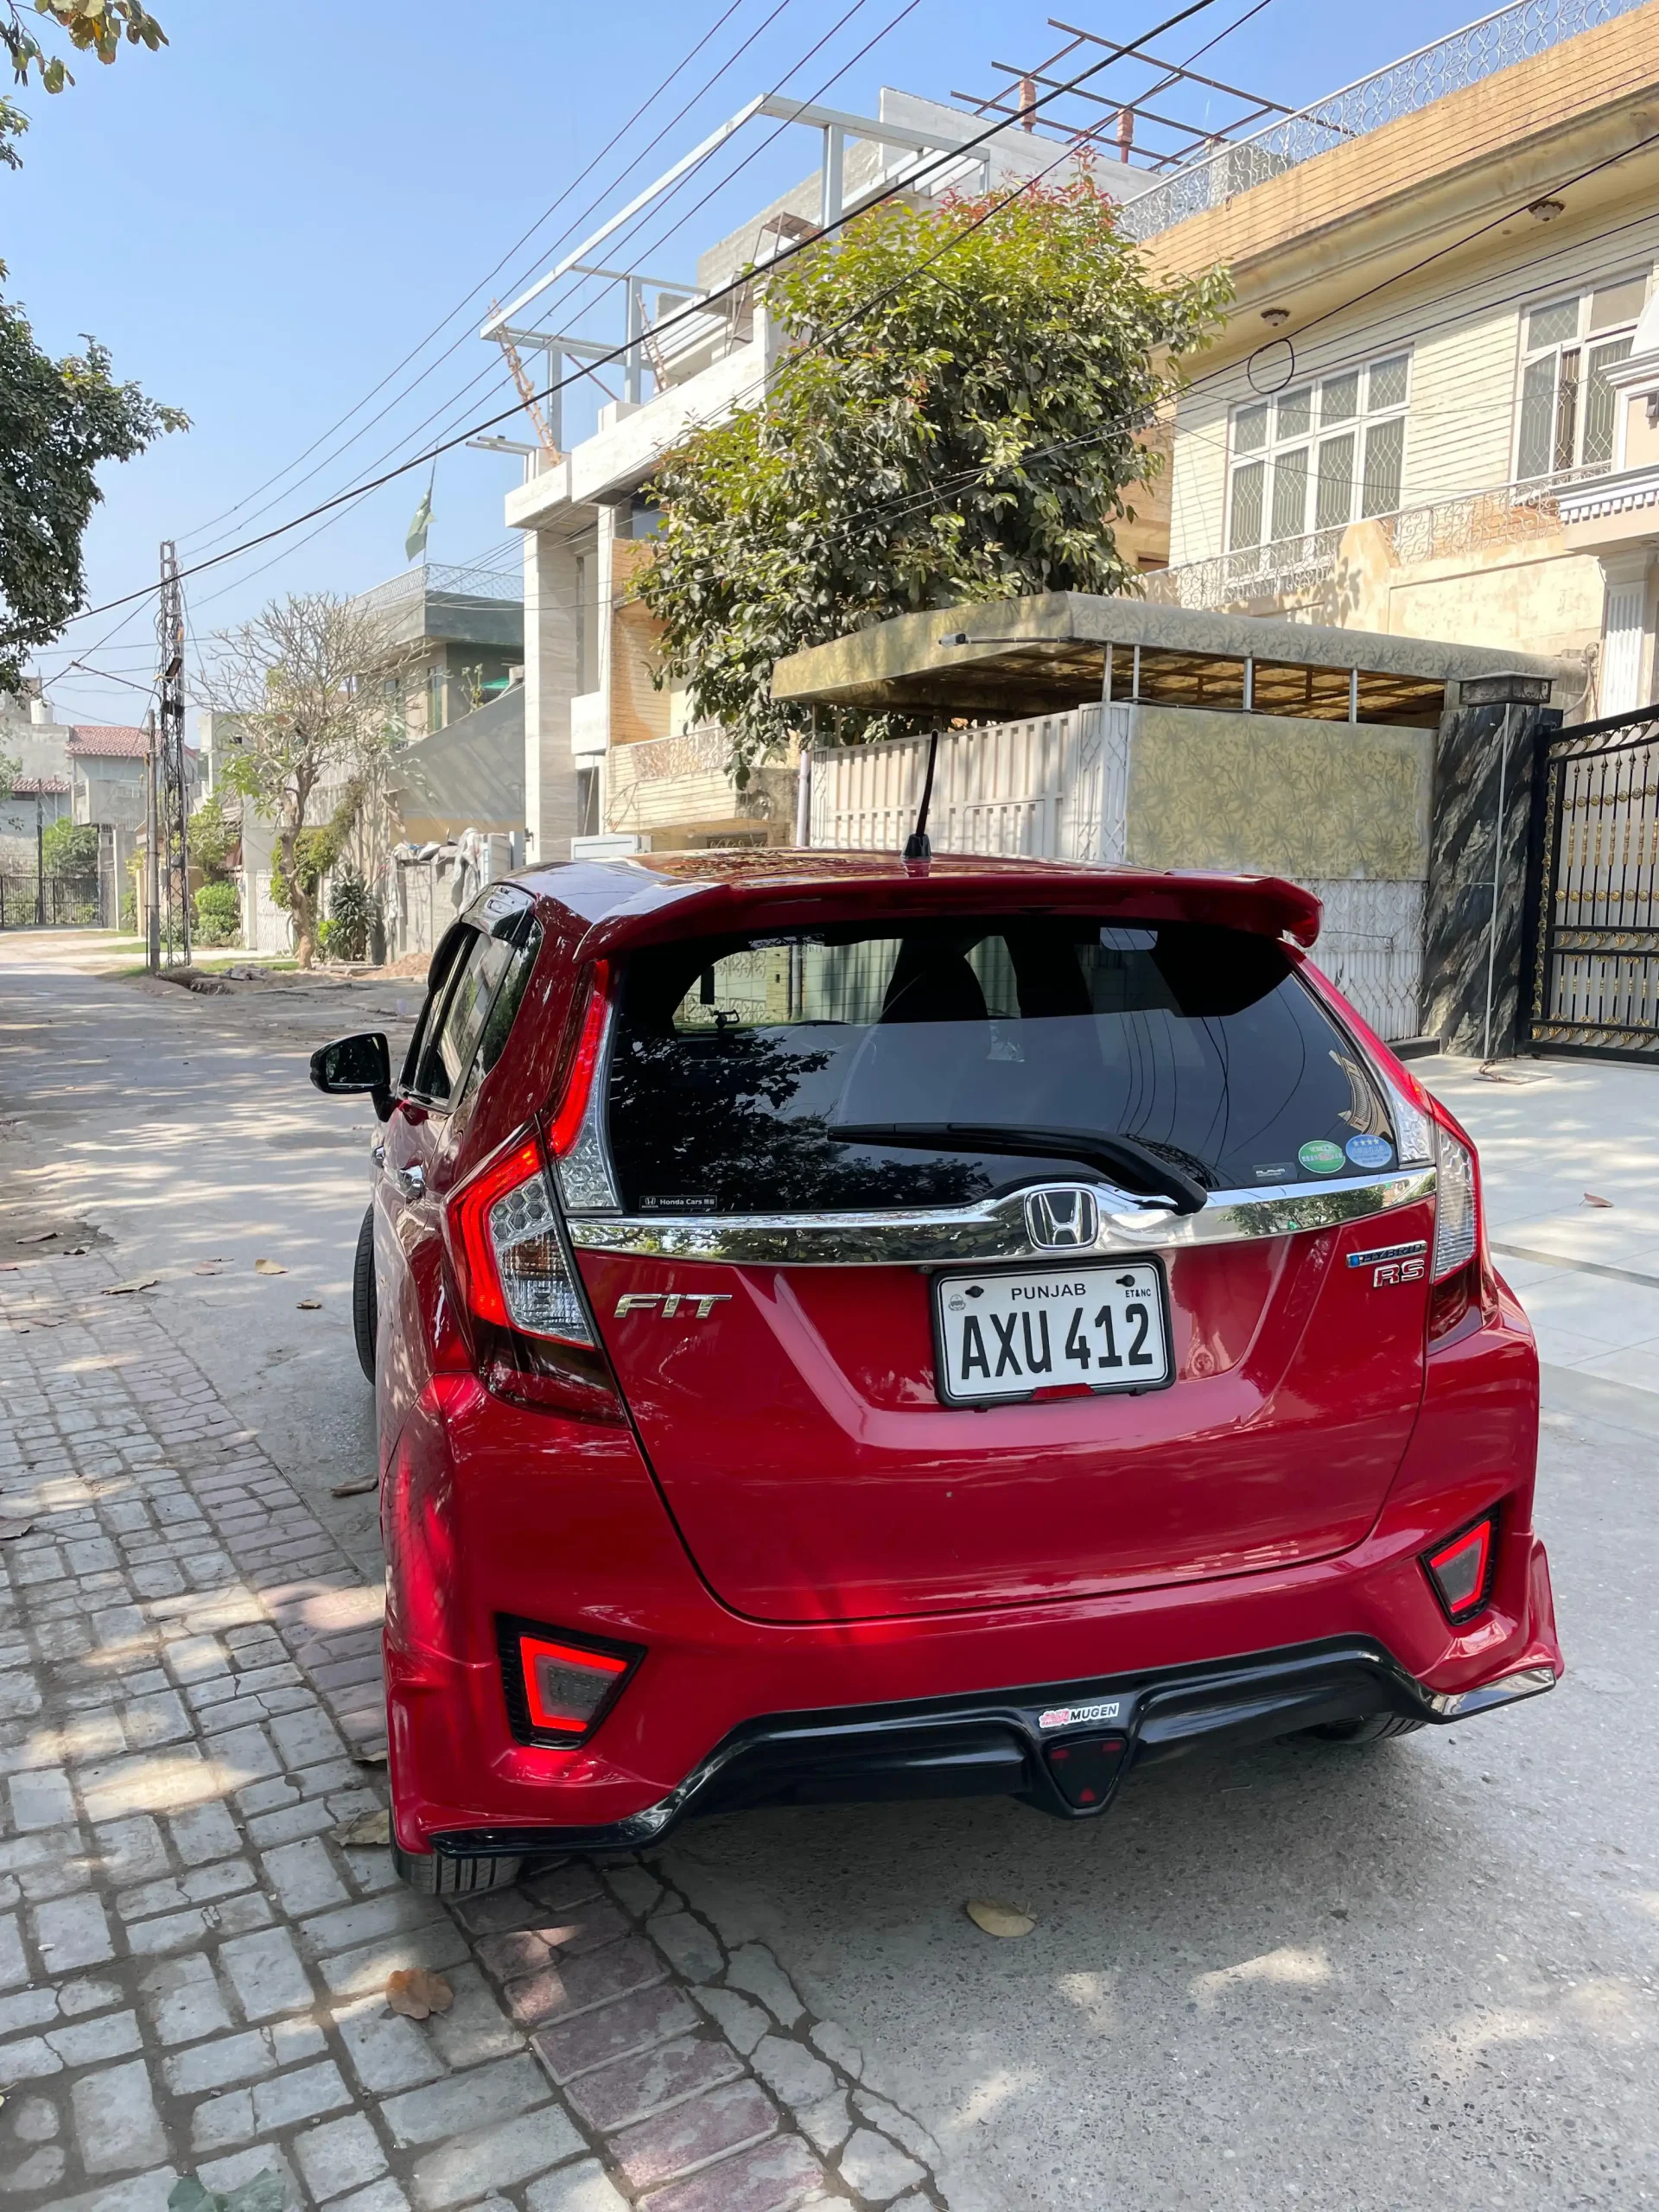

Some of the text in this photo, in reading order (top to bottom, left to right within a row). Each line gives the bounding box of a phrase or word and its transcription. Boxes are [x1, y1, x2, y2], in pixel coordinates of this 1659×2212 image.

[1361, 1244, 1422, 1262] HYBRID
[1373, 1258, 1425, 1288] RS
[1011, 1283, 1087, 1300] PUNJAB
[1125, 1288, 1152, 1298] ET&NC
[613, 1294, 733, 1319] FIT
[961, 1303, 1153, 1380] AXU 412
[1071, 1705, 1116, 1720] MUGEN
